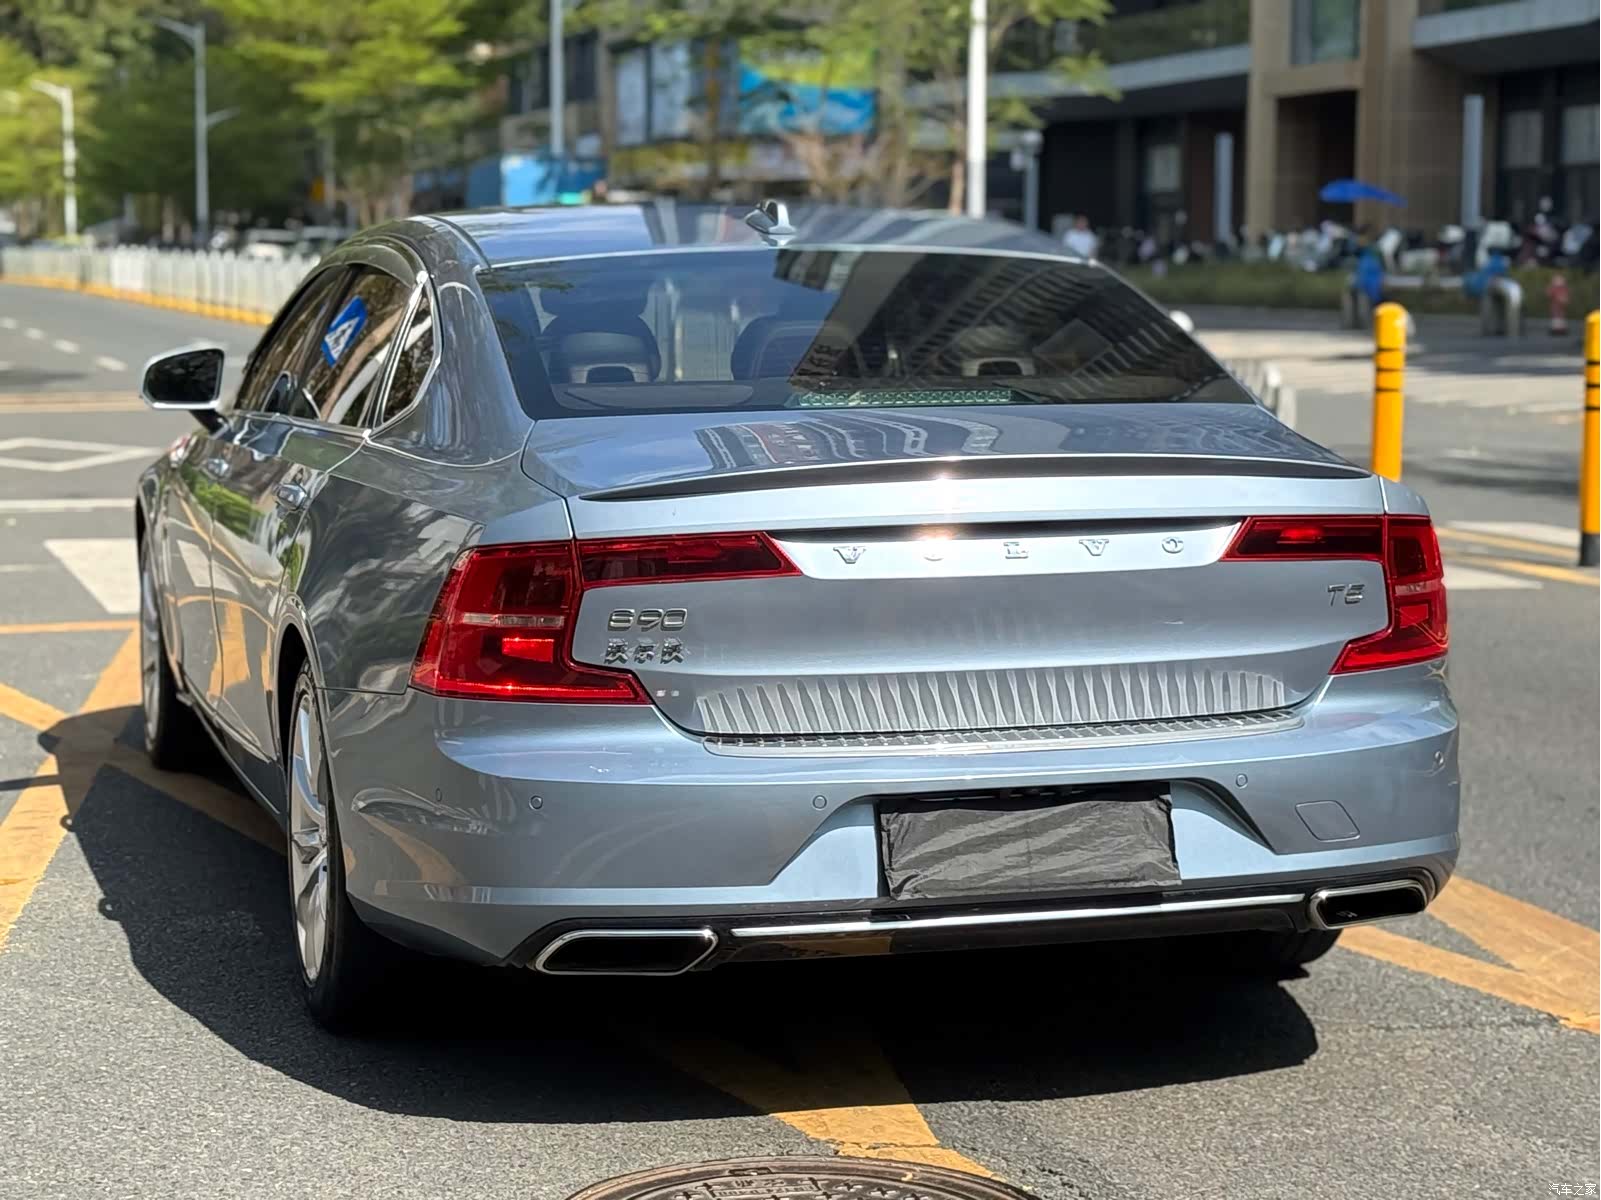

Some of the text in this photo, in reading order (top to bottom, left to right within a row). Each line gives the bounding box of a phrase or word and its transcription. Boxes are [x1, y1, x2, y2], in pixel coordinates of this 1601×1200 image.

[607, 607, 688, 632] S90
[603, 636, 685, 665] 沃尔沃
